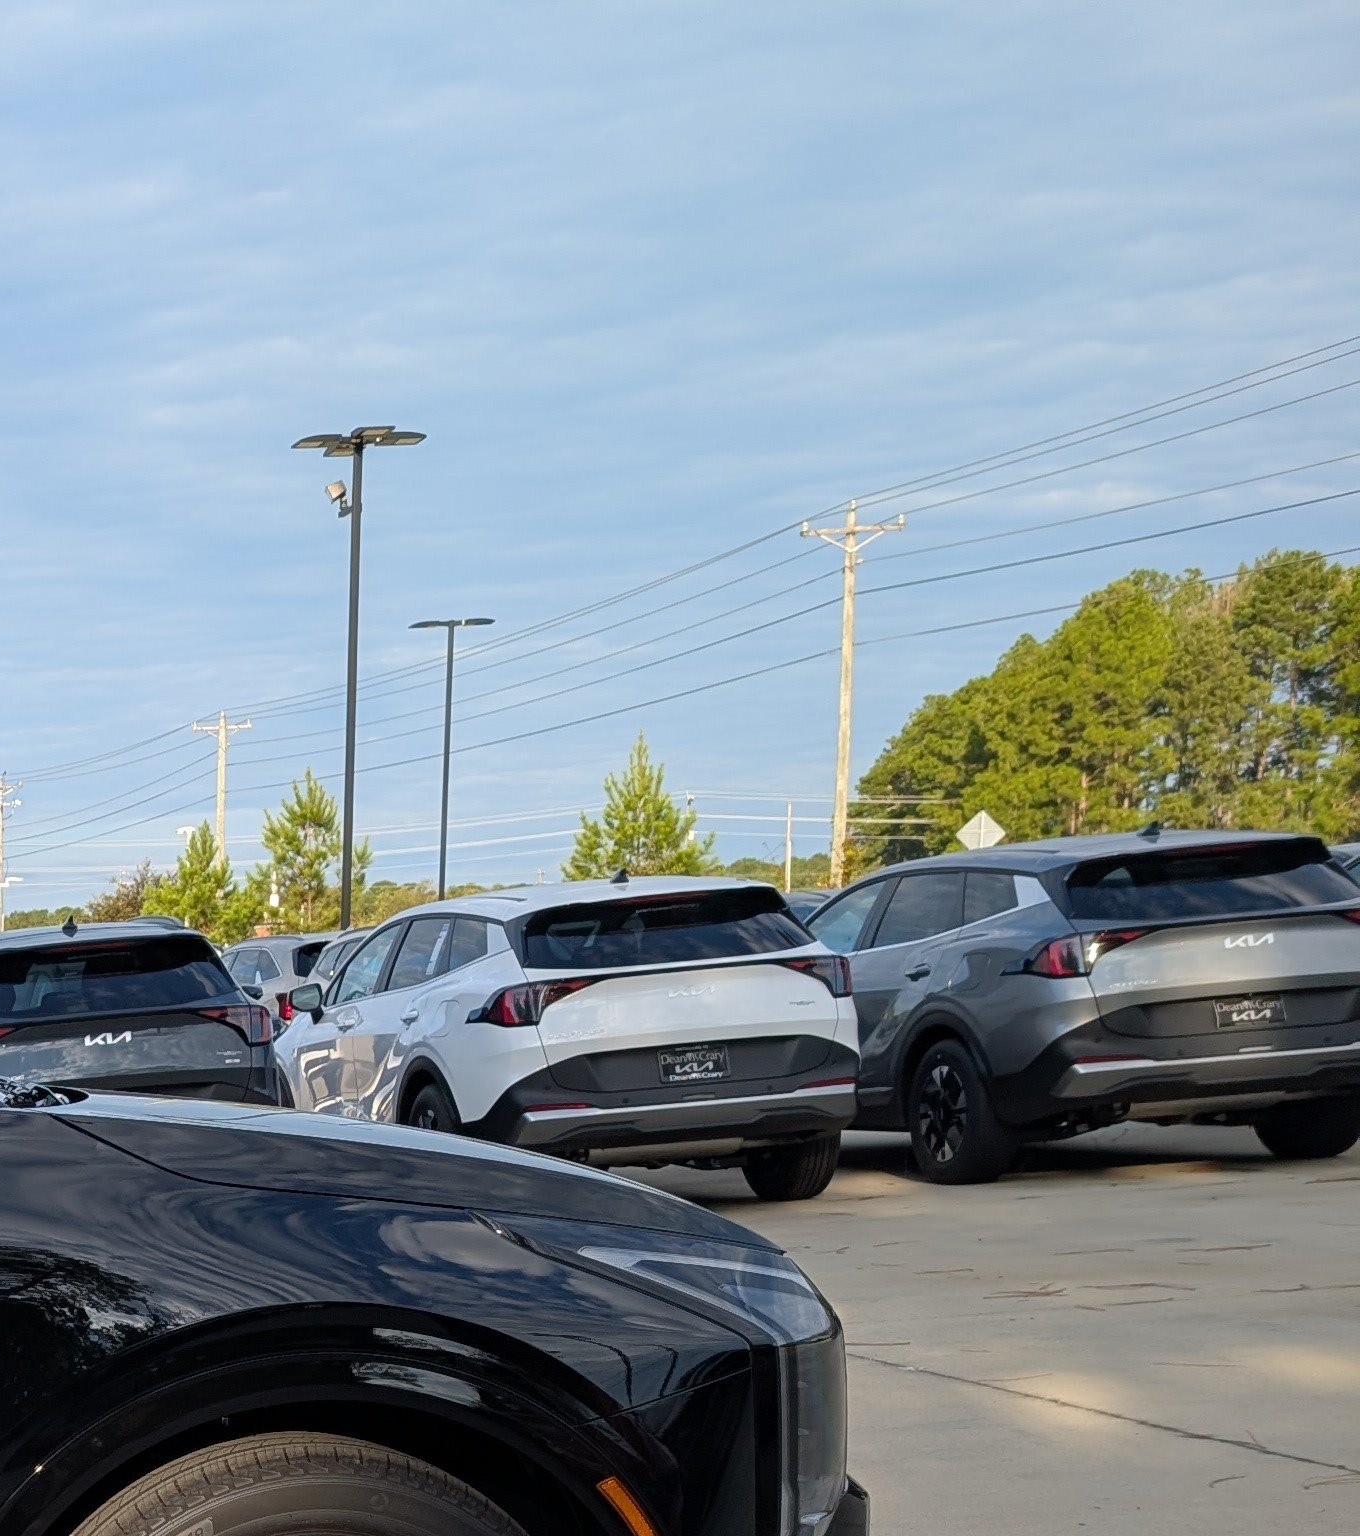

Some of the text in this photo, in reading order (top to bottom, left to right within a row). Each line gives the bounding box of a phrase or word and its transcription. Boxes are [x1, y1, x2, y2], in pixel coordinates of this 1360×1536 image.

[1224, 932, 1275, 949] KIA
[84, 1030, 132, 1047] KIA
[675, 1061, 714, 1073] KIA
